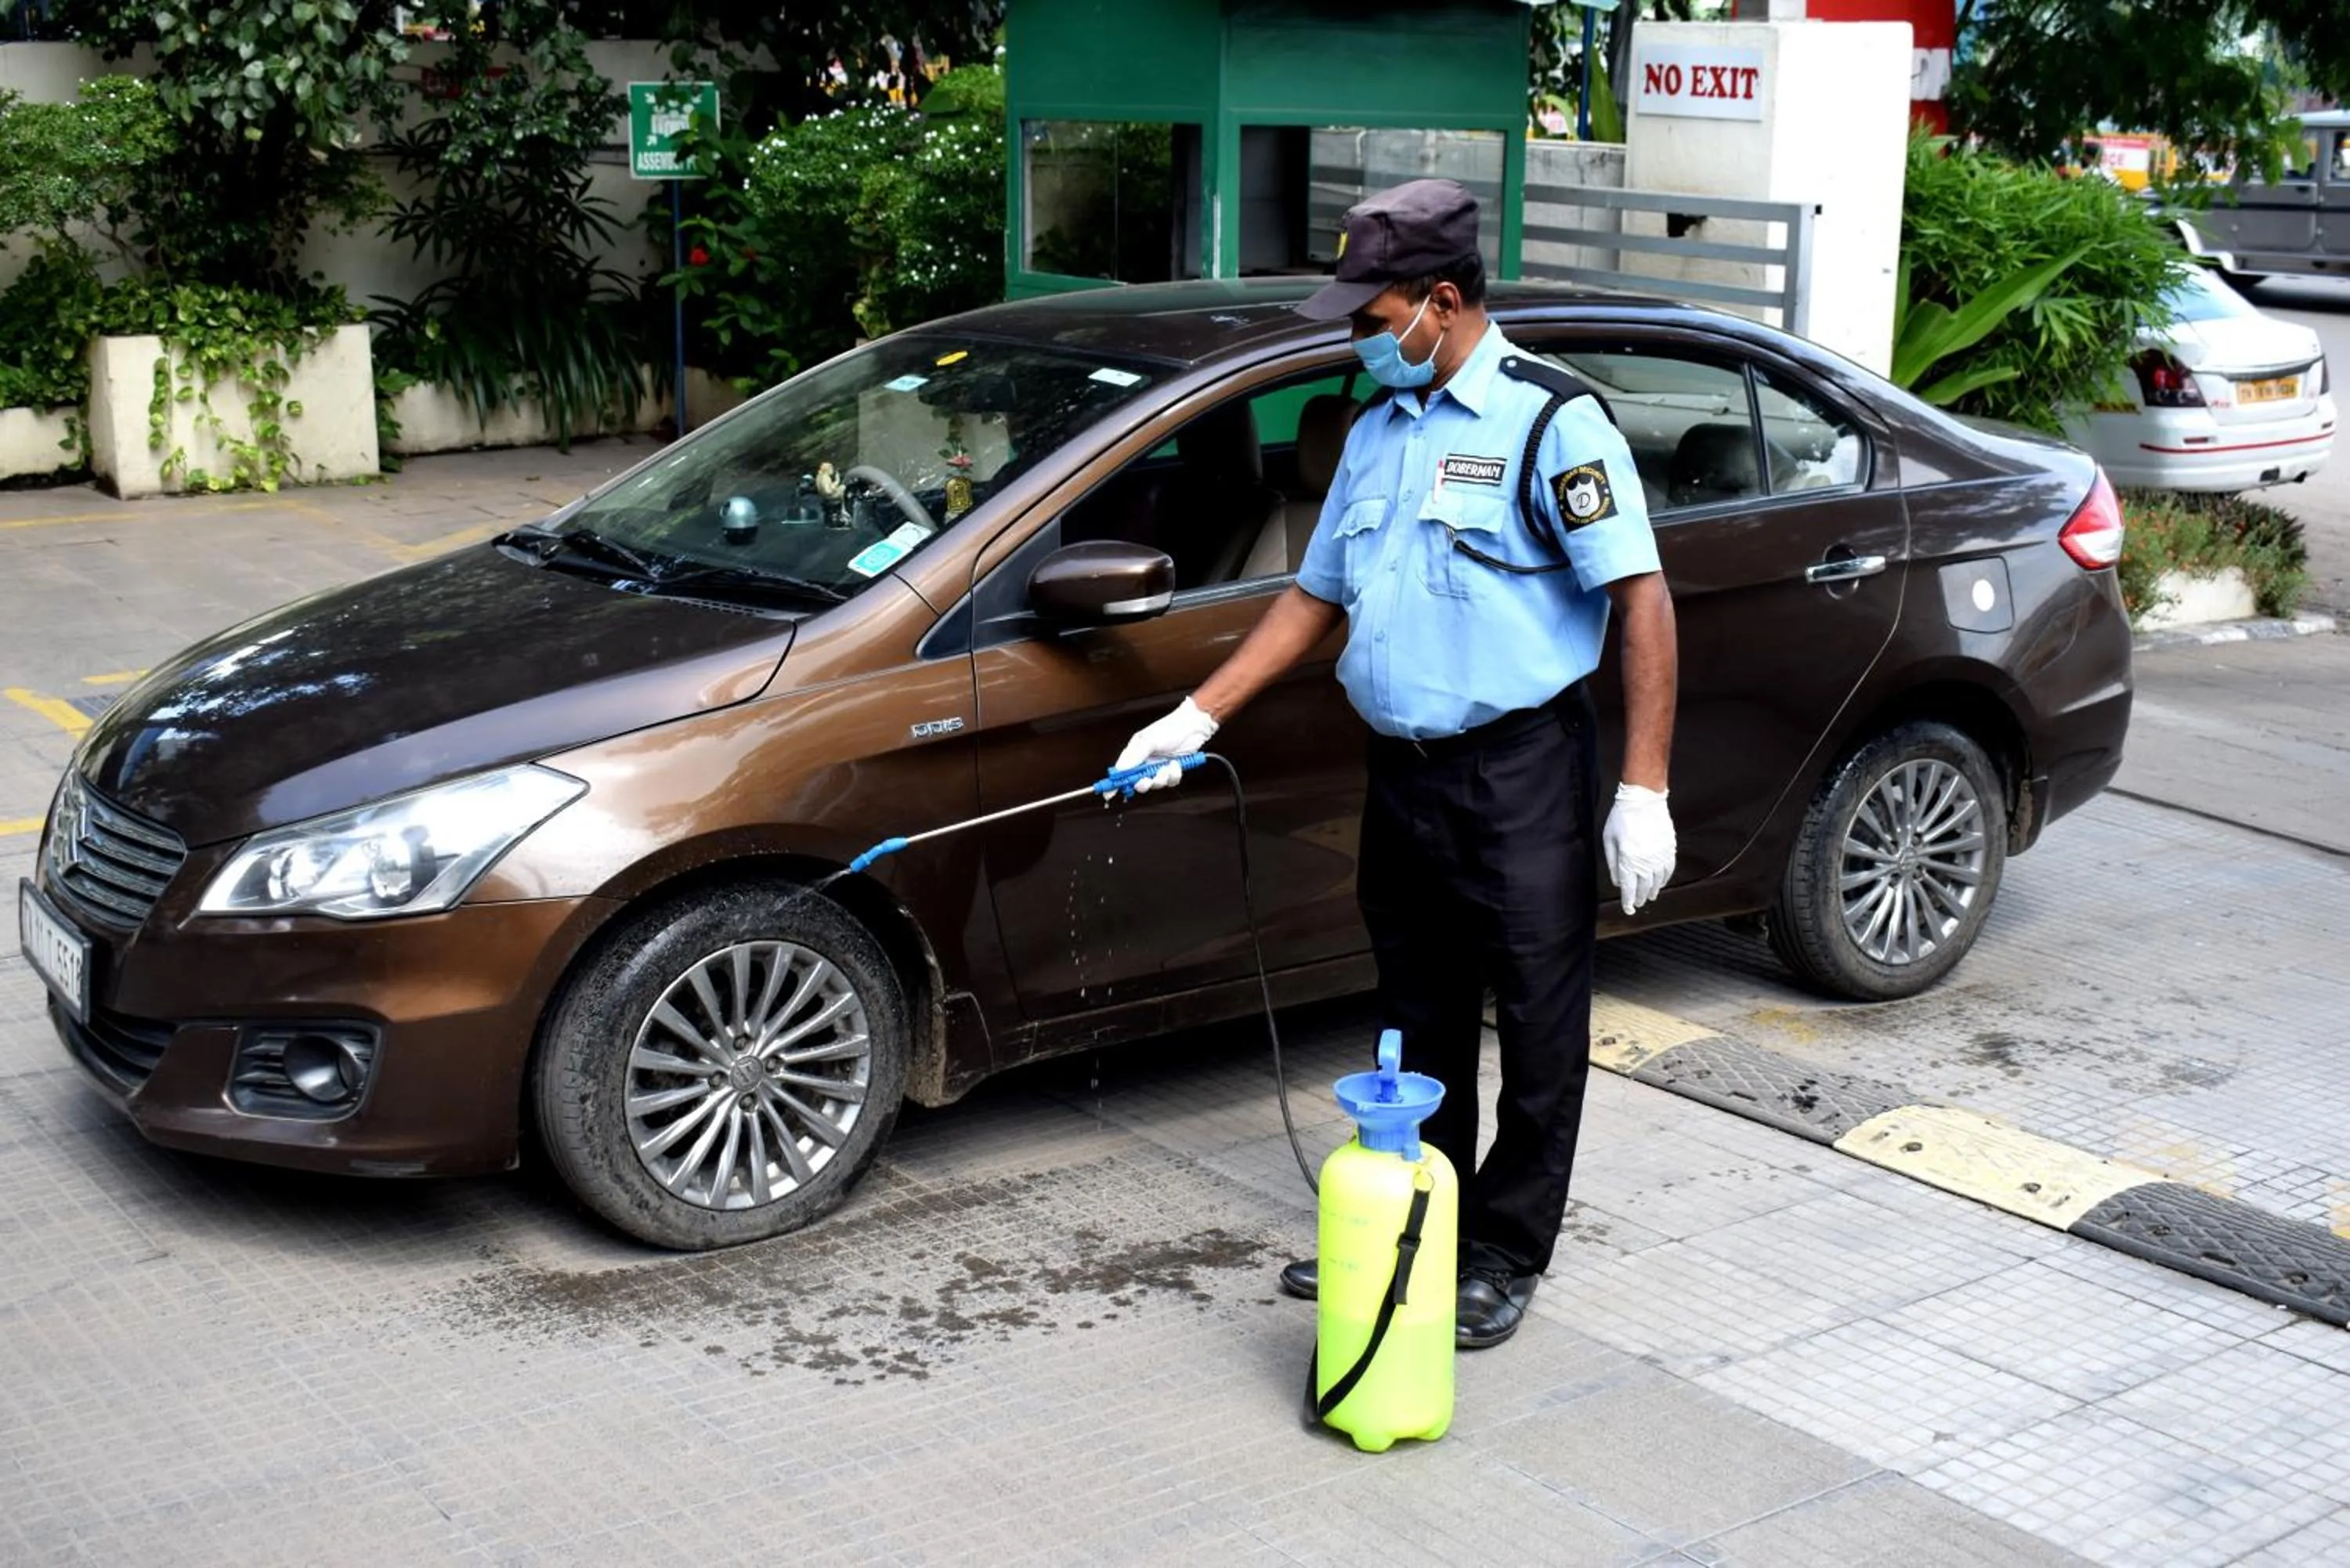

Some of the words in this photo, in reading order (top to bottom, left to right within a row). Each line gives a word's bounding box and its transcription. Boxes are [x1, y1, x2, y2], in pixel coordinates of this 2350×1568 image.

[1643, 63, 1682, 96] NO
[1690, 65, 1759, 99] EXIT
[1446, 461, 1501, 479] DOBERMAN
